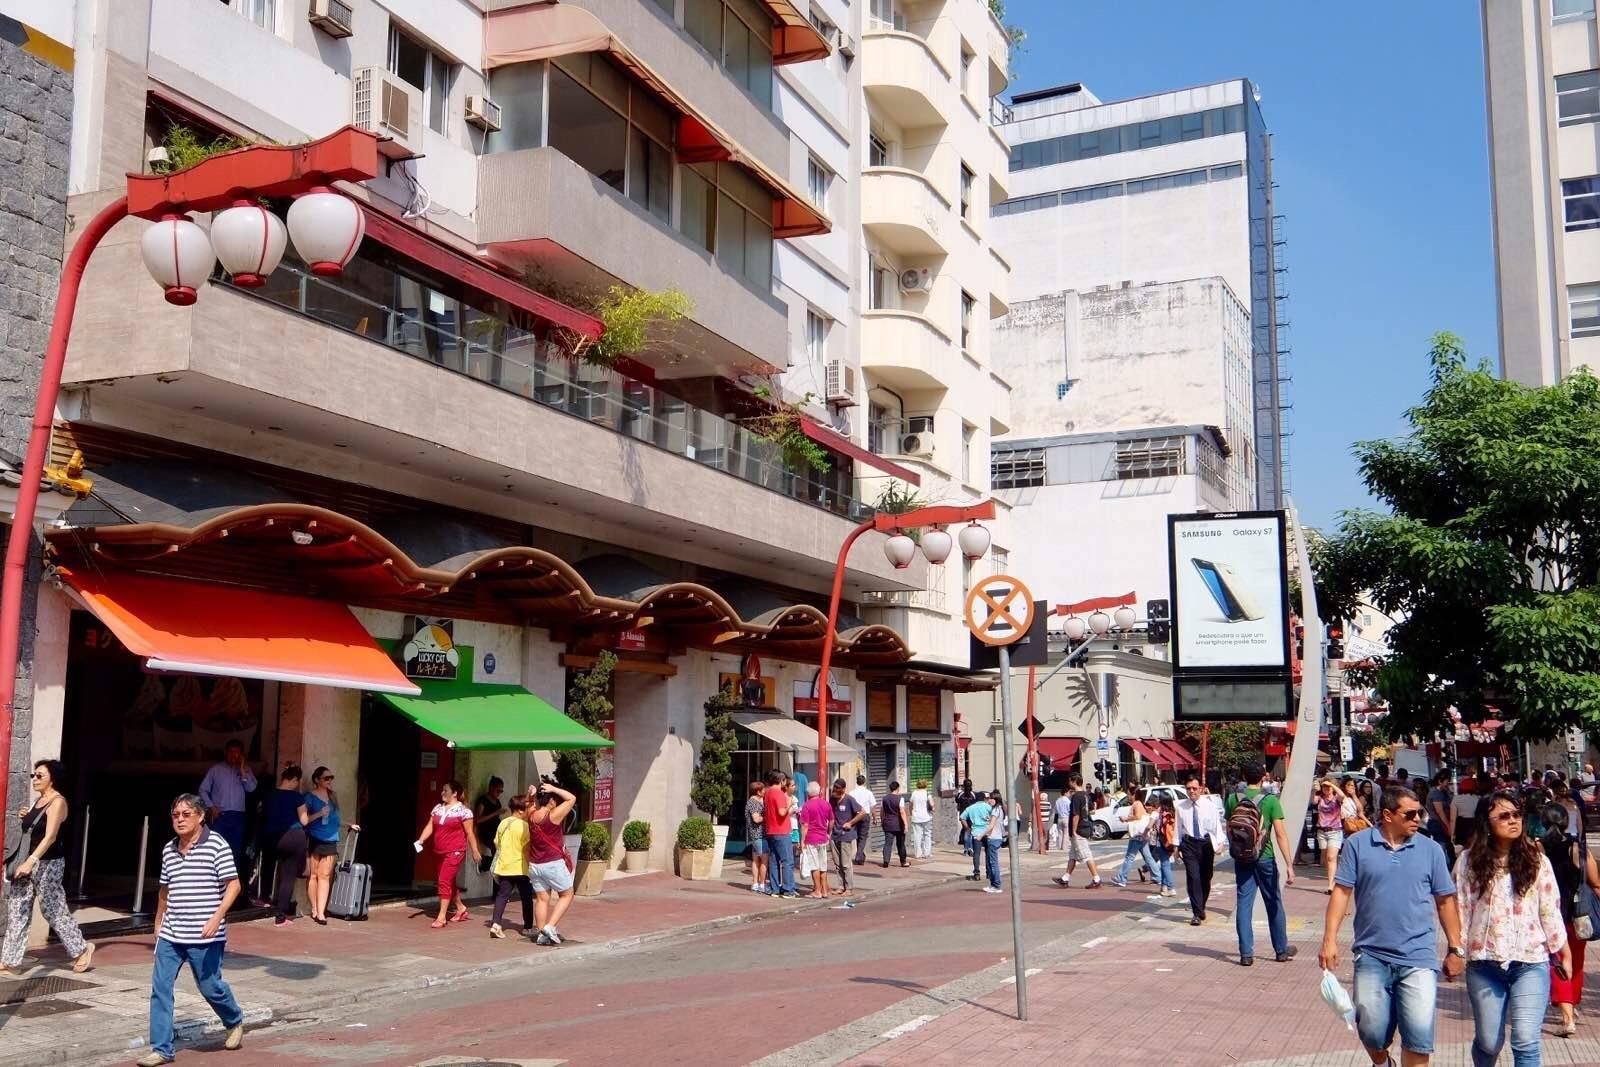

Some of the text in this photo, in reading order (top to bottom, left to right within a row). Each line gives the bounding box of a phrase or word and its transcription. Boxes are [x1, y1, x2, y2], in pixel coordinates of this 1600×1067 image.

[1182, 530, 1222, 538] SAMSUNG
[418, 652, 446, 663] LUCKY CAT
